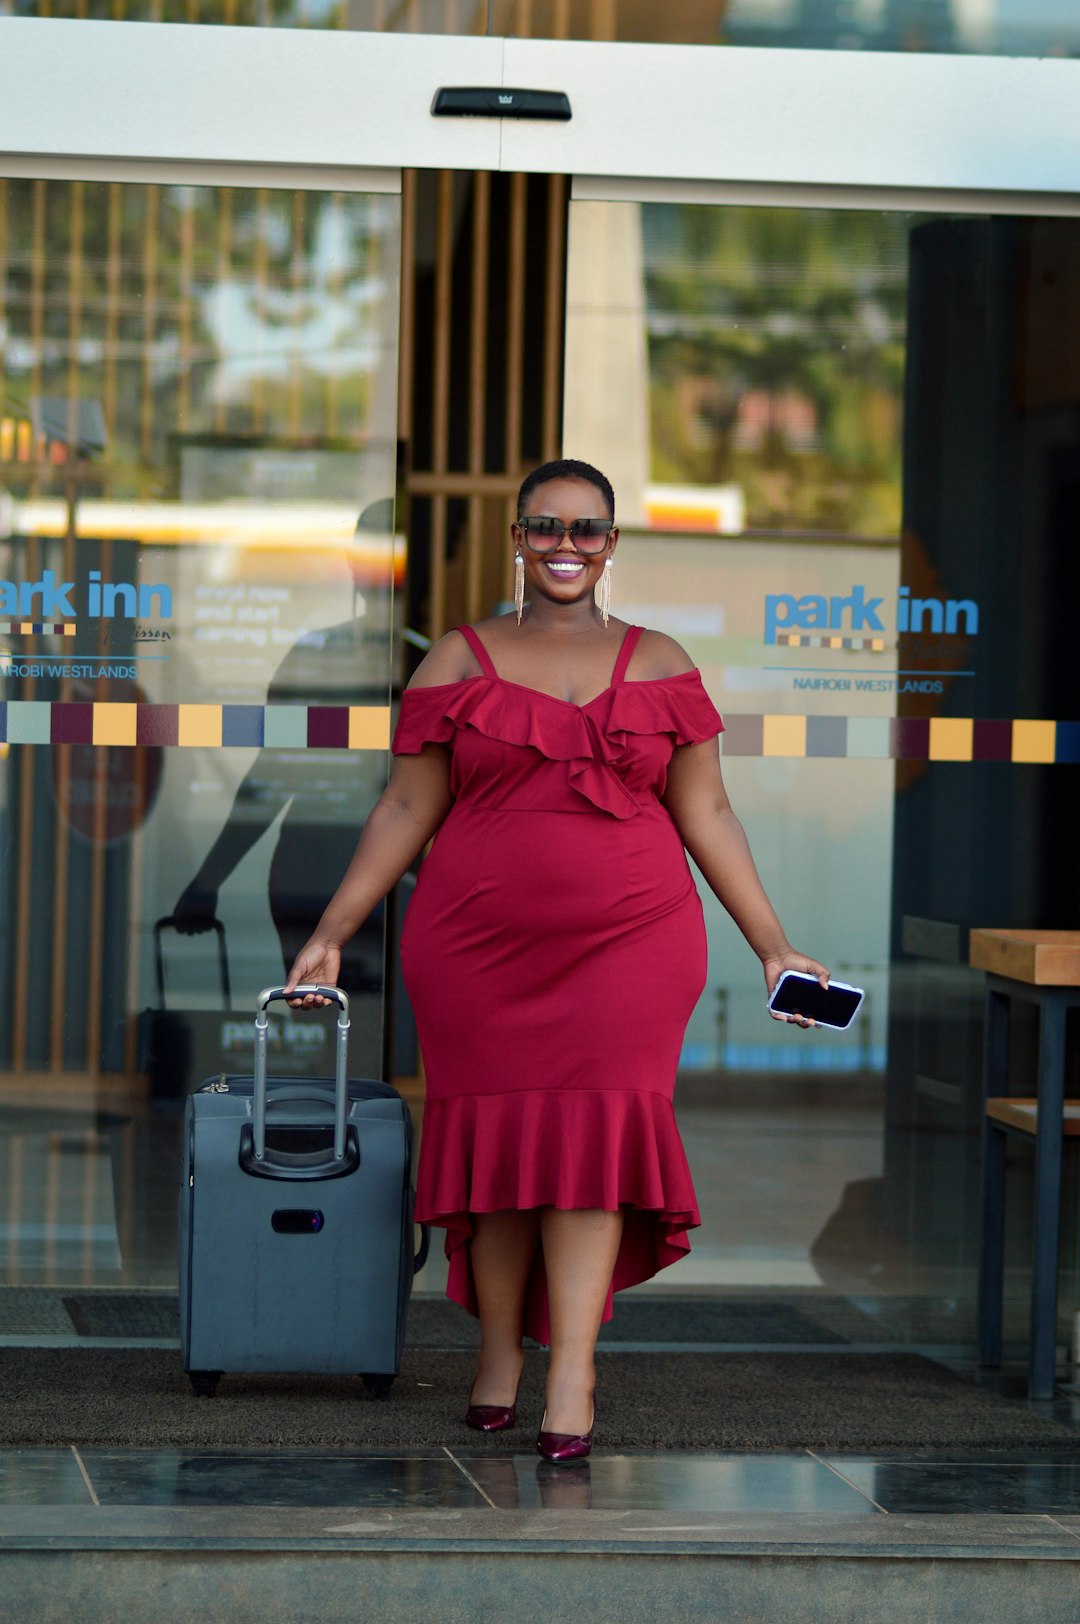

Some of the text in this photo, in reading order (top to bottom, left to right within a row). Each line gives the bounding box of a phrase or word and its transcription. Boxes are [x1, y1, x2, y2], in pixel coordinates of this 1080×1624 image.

[88, 570, 173, 618] inn
[763, 585, 979, 646] park inn
[48, 664, 138, 679] WESTLANDS
[793, 678, 943, 694] NAIROBI WESTLANDS
[223, 1020, 281, 1050] pak
